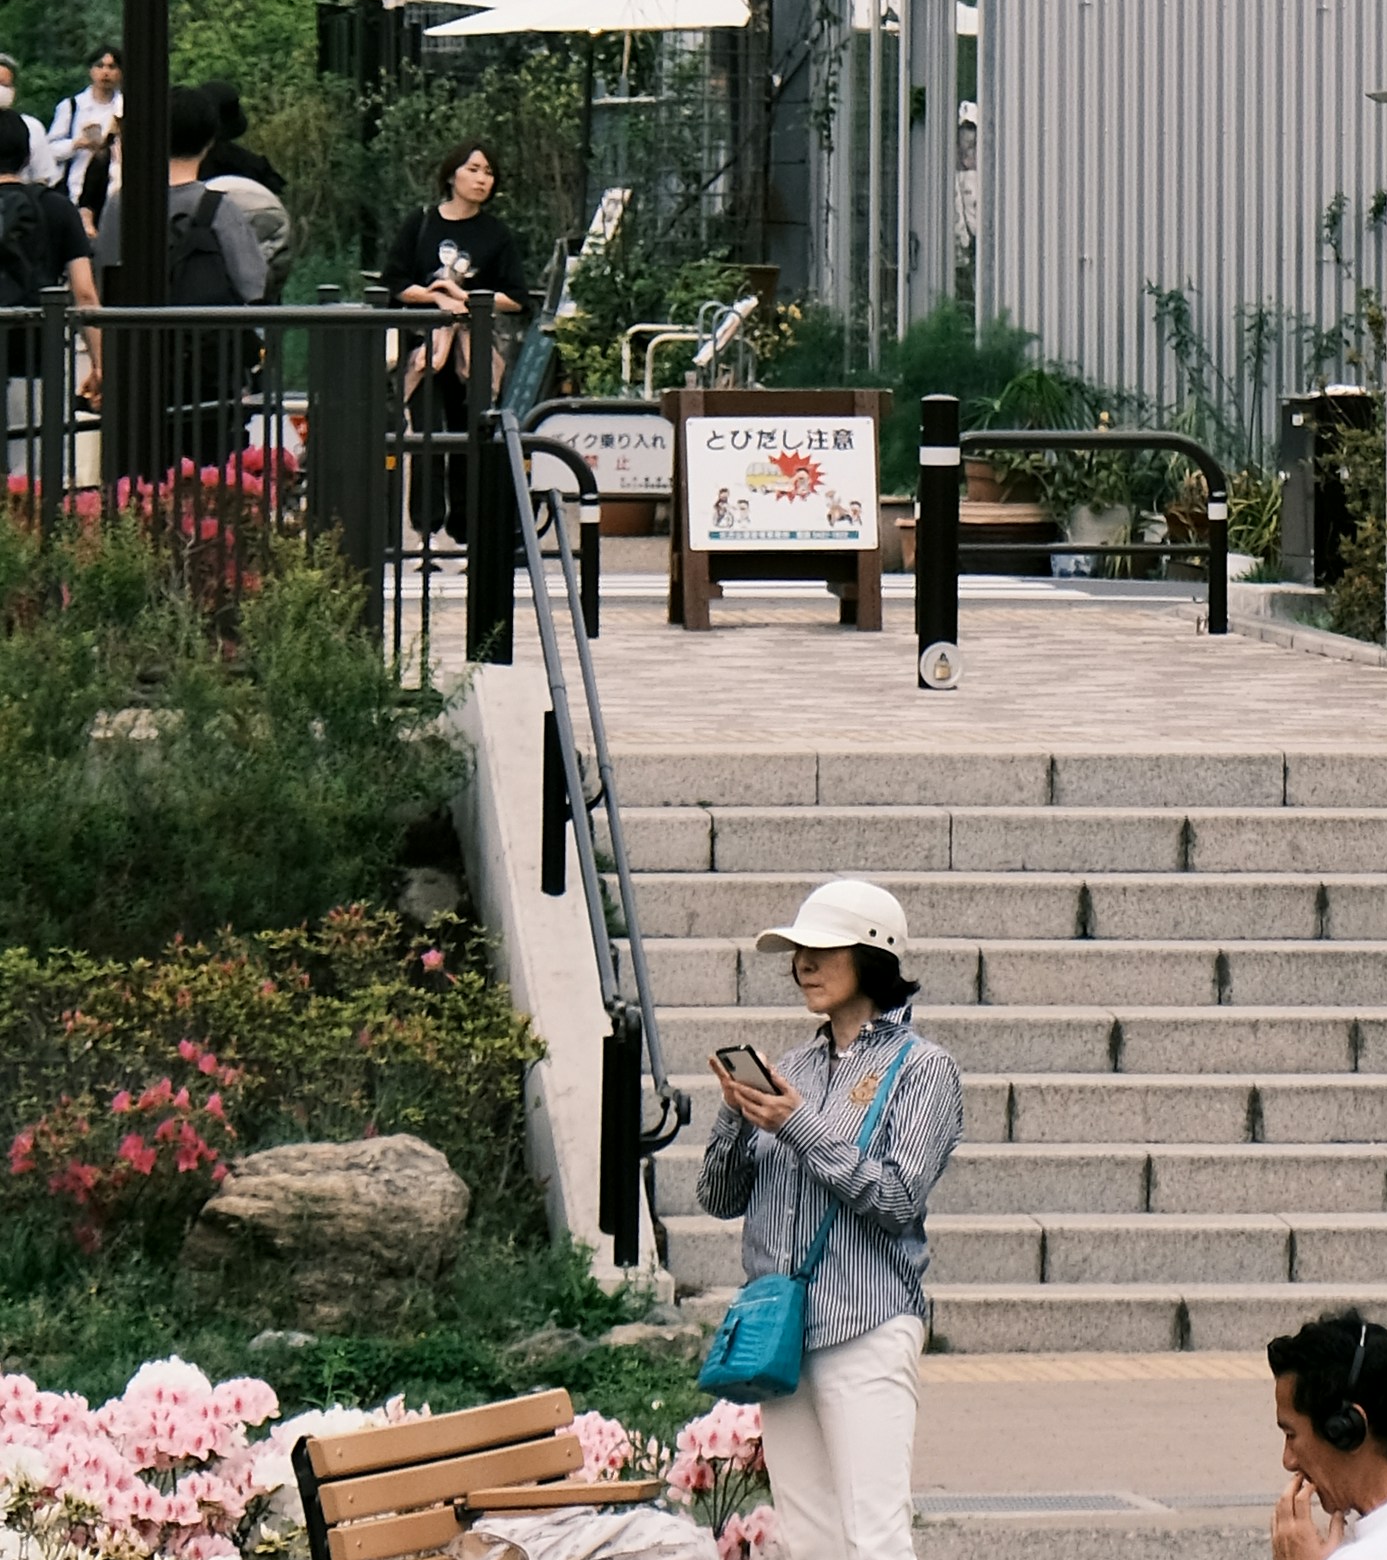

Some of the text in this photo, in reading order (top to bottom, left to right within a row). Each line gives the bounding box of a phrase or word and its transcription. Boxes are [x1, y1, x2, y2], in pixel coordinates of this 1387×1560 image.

[707, 428, 854, 450] とびだし注意
